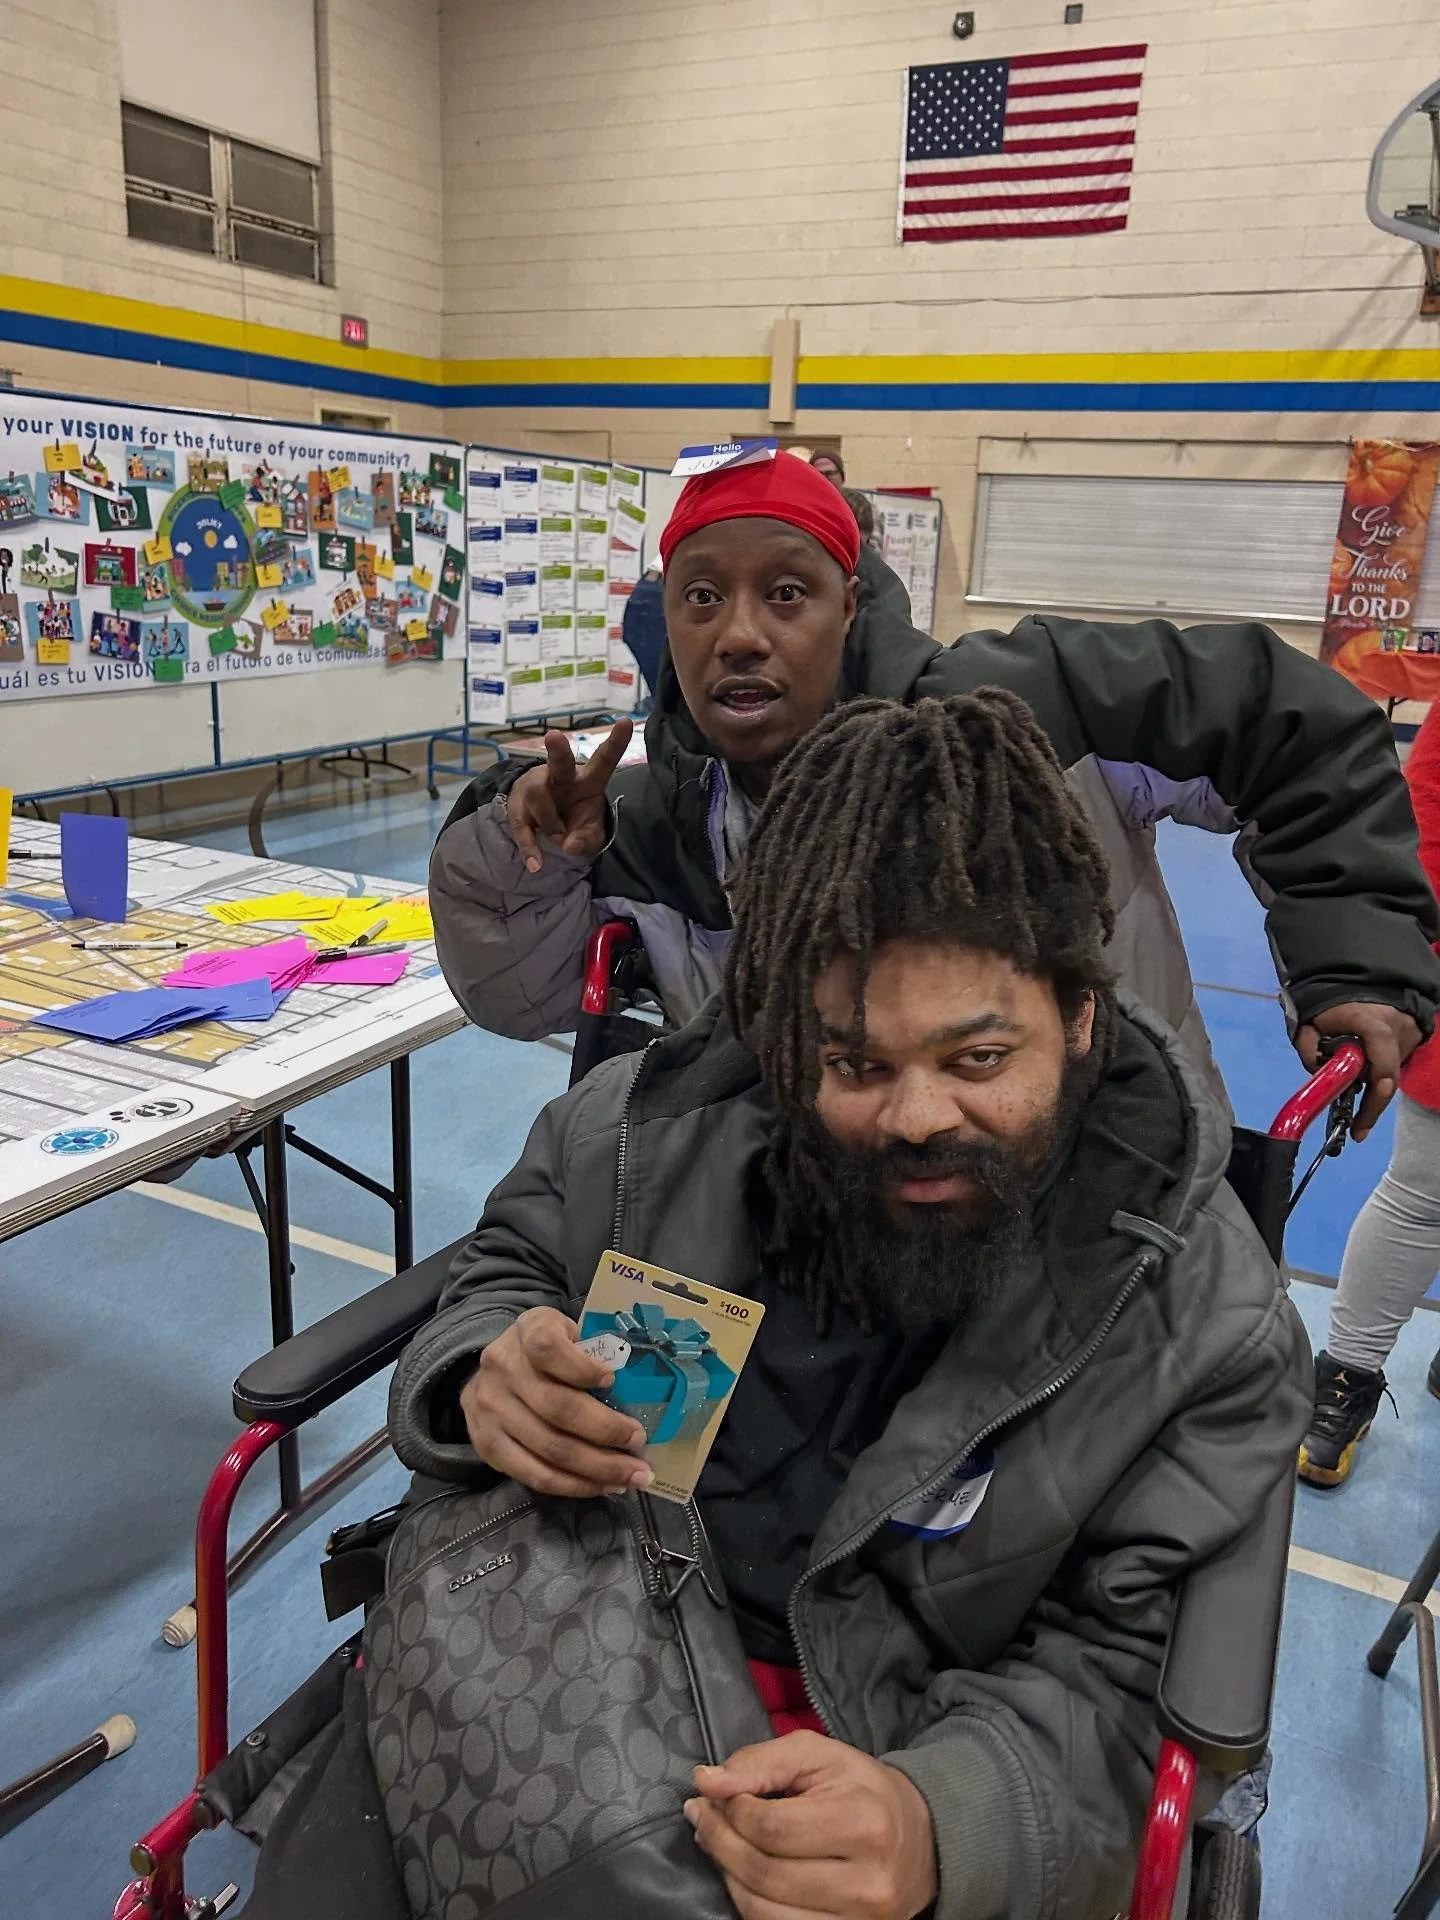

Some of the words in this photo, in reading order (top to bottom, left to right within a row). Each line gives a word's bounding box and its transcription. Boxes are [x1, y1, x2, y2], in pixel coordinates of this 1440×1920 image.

[4, 416, 54, 436] your
[61, 418, 134, 443] VISION
[140, 426, 168, 446] for
[174, 430, 203, 449] the
[209, 434, 262, 454] future
[268, 441, 284, 455] of
[289, 445, 324, 461] your
[328, 449, 410, 470] community?
[713, 443, 742, 453] Hello
[1351, 504, 1407, 547] Give
[1344, 545, 1408, 580] Thanks
[1351, 583, 1365, 593] TO
[1368, 583, 1386, 593] THE
[1331, 593, 1410, 620] LORD
[0, 670, 29, 690] uál
[38, 672, 60, 687] es
[67, 667, 86, 684] tu
[207, 656, 220, 672] el
[226, 654, 272, 671] futuro
[277, 652, 293, 666] de
[299, 650, 311, 664] tu
[317, 645, 388, 663] comundad
[610, 1260, 645, 1284] VISA
[720, 1300, 749, 1319] $100
[448, 1553, 512, 1593] COACH
